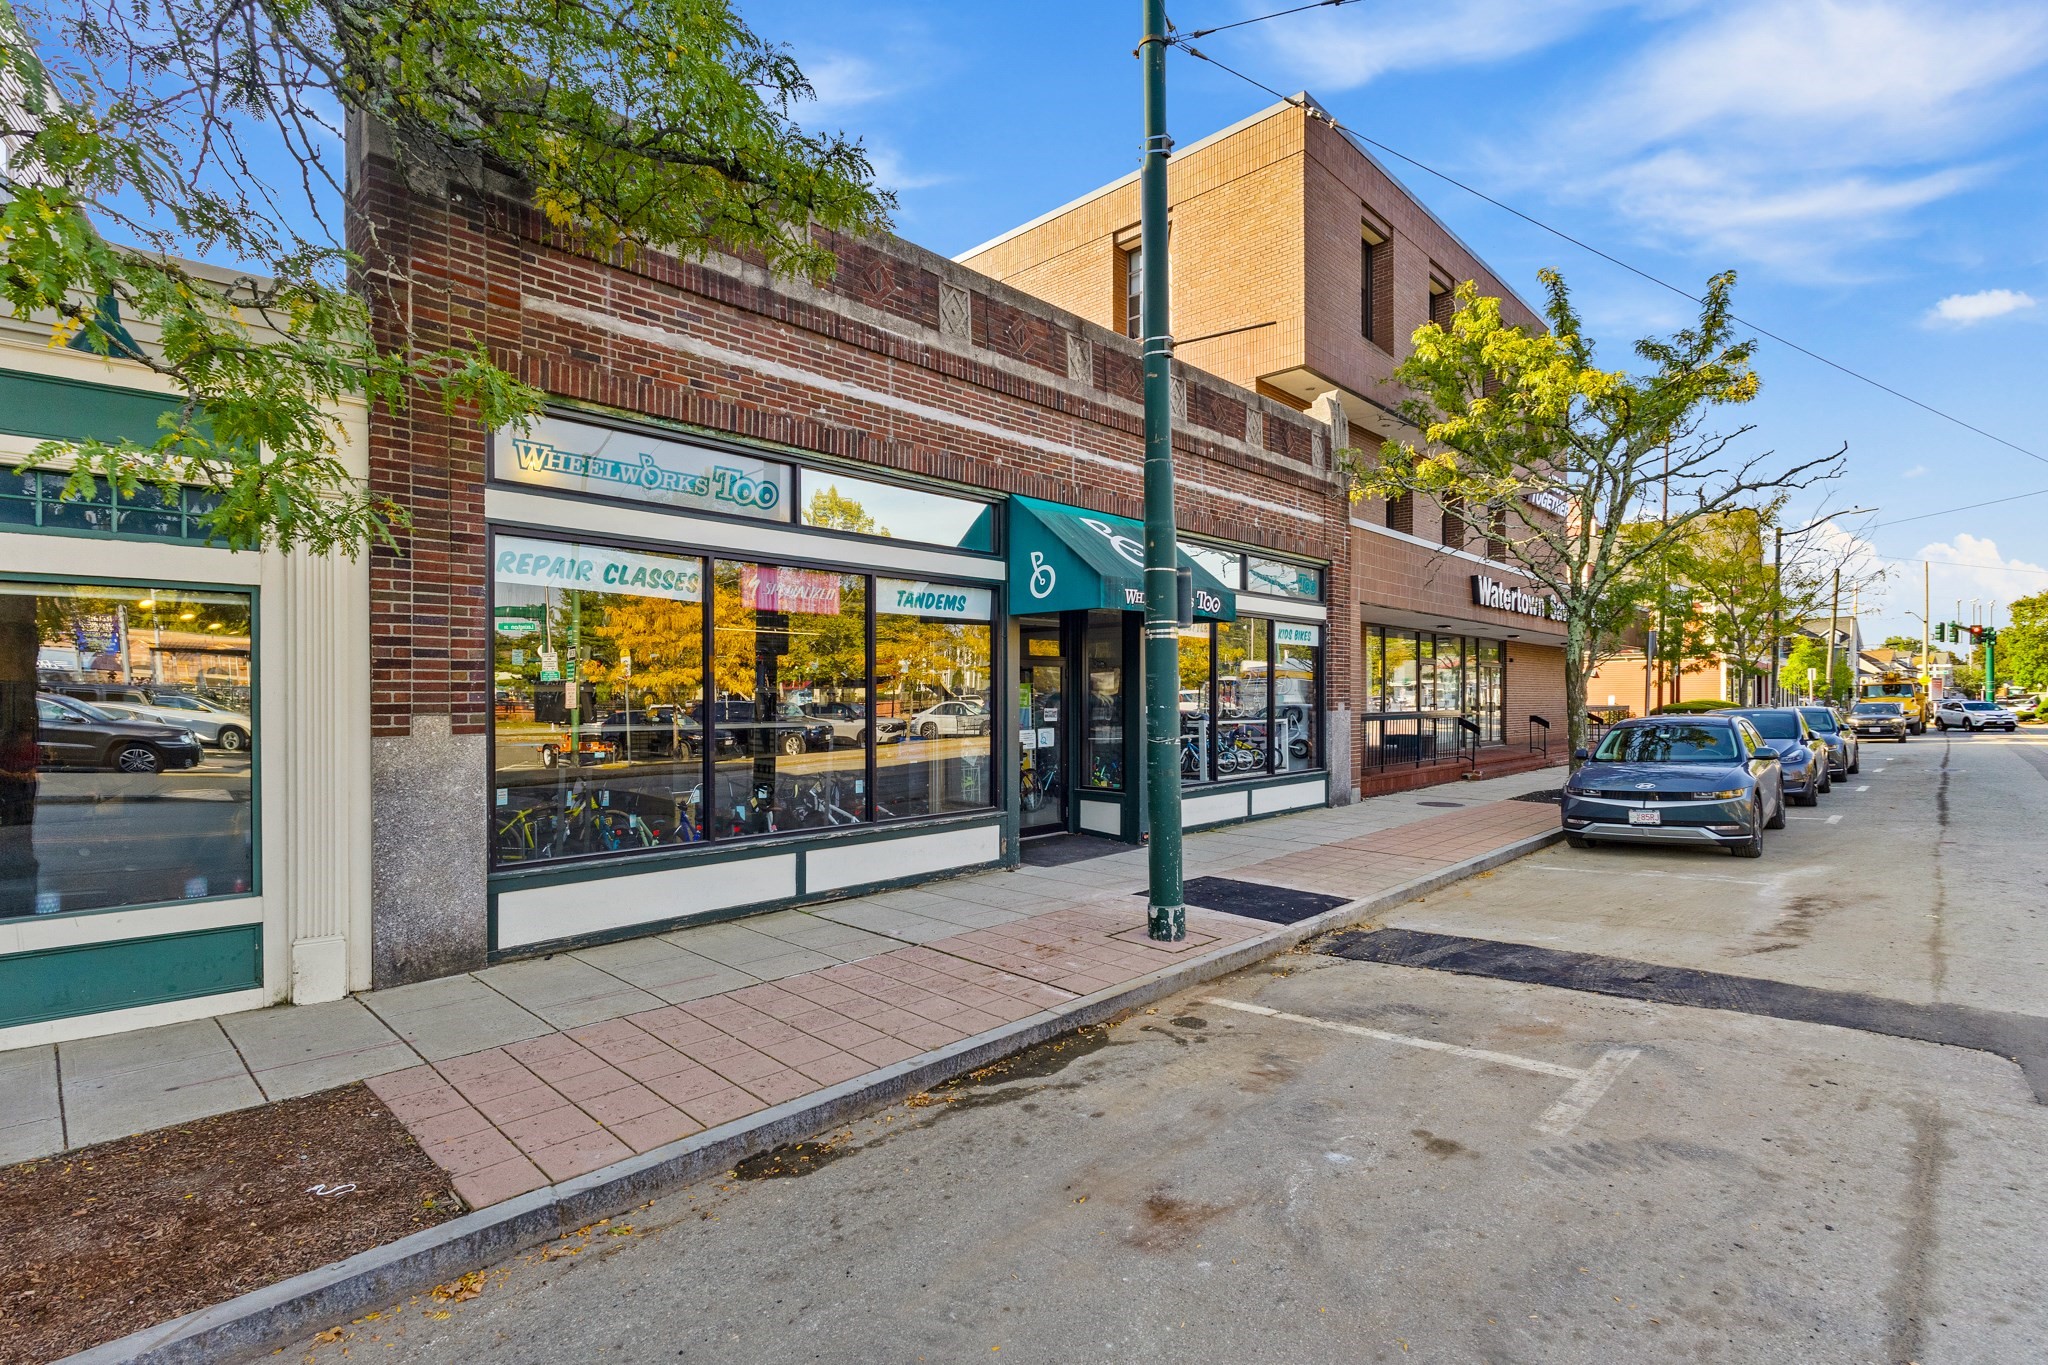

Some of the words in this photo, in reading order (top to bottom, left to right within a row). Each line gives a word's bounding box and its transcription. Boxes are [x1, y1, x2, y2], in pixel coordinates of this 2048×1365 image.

[496, 550, 594, 582] REPAIR
[602, 562, 700, 594] CLASSES
[896, 589, 967, 612] TANDEMS
[1478, 575, 1544, 616] Watertown
[1277, 628, 1293, 641] KIDS
[1294, 628, 1312, 642] BIKES
